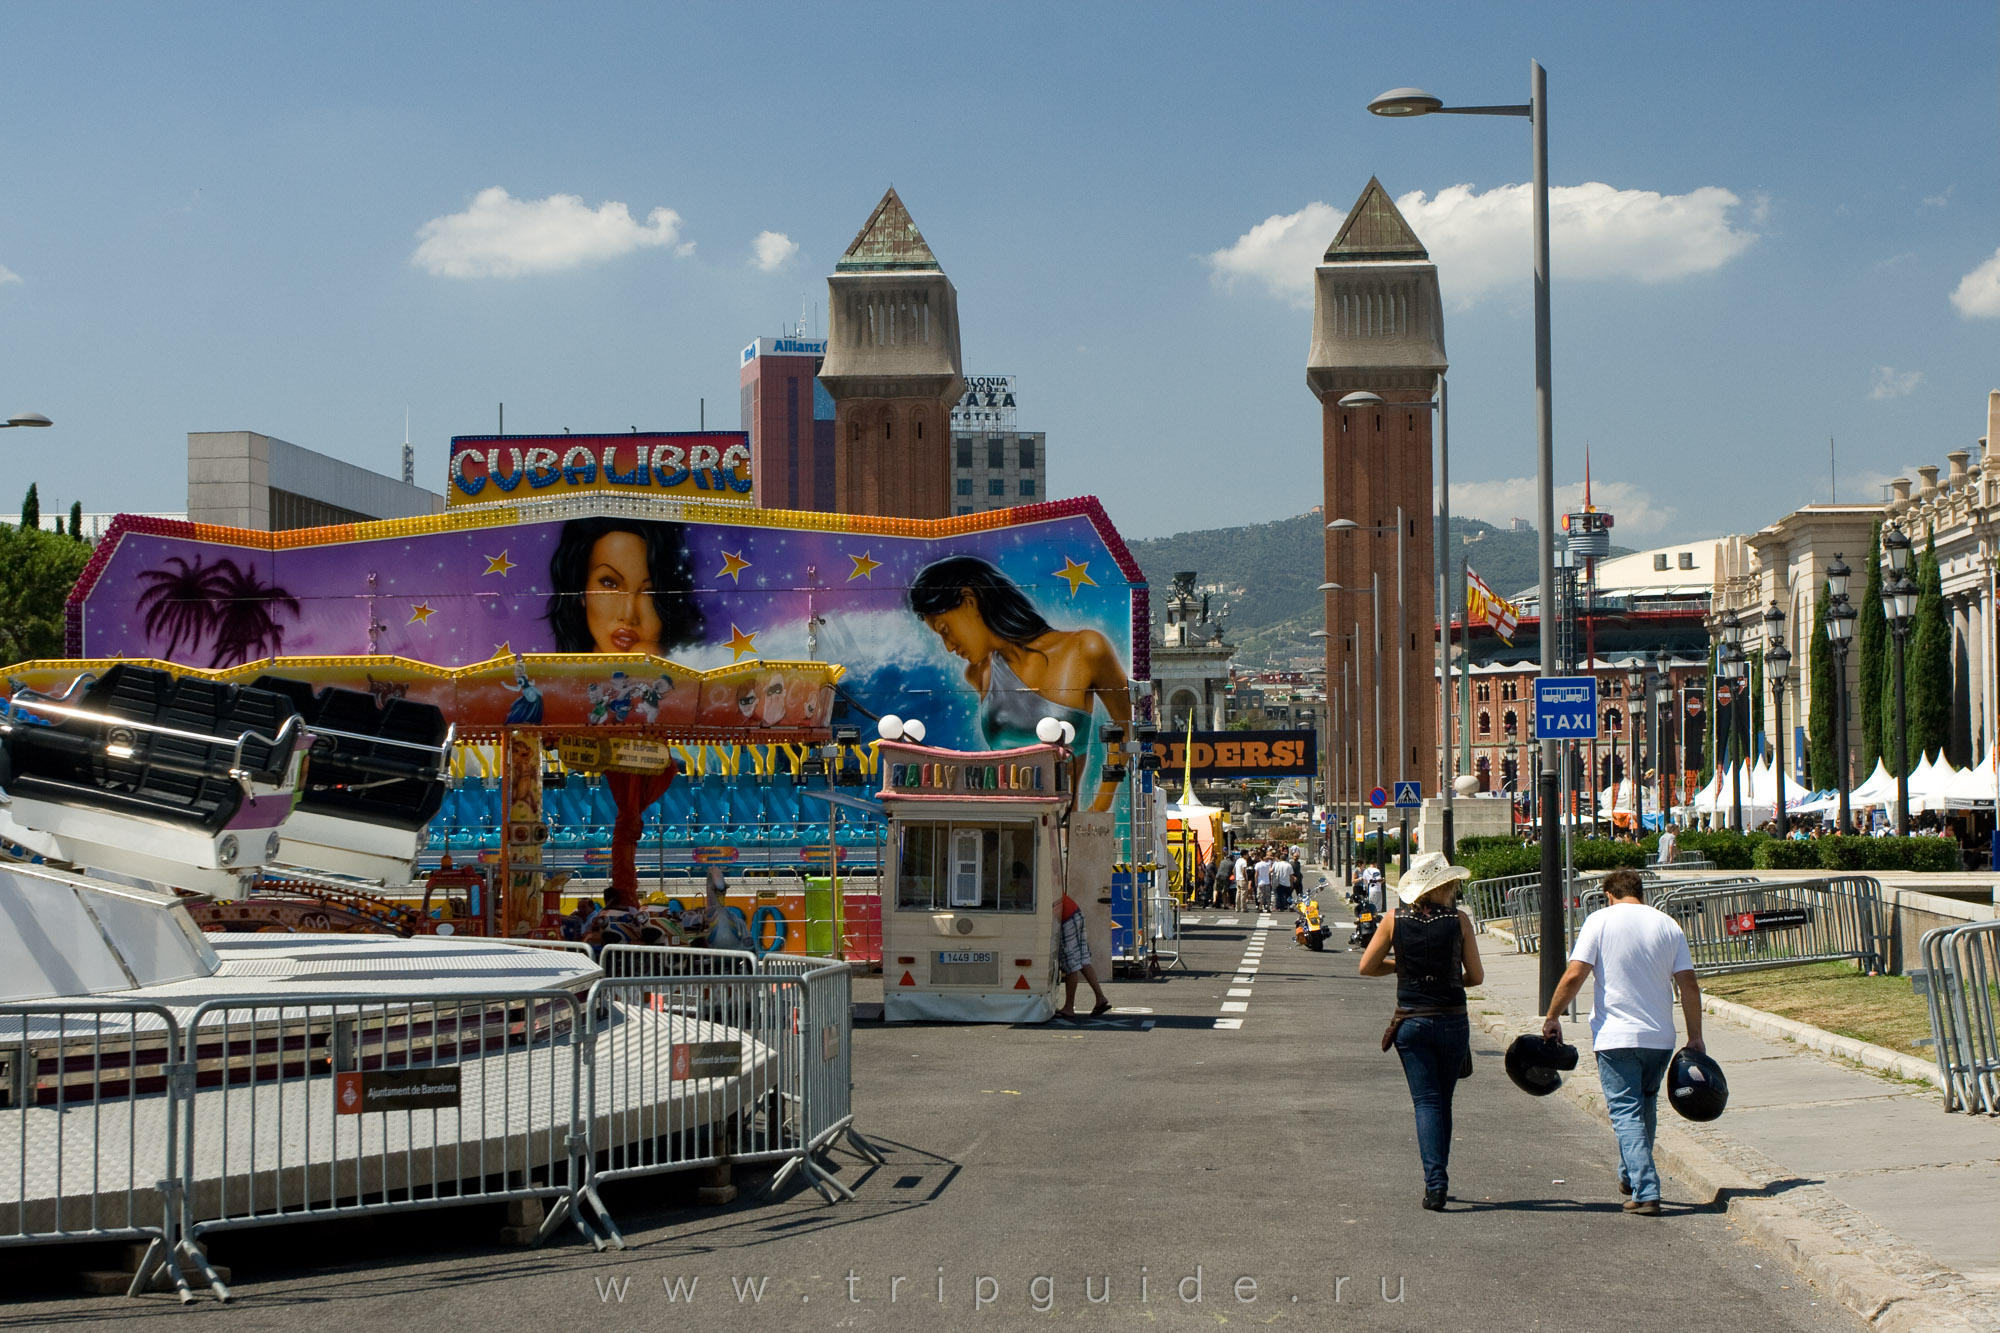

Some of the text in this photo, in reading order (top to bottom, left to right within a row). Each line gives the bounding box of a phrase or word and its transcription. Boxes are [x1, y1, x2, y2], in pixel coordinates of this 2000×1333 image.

[774, 340, 821, 353] Allianz
[951, 412, 1000, 420] HOTEL
[1542, 714, 1591, 730] TAXI
[891, 763, 1044, 790] RALLY MALLOL
[948, 953, 990, 962] 1449 DBS
[368, 1083, 457, 1100] Ajuntament de Barcelona
